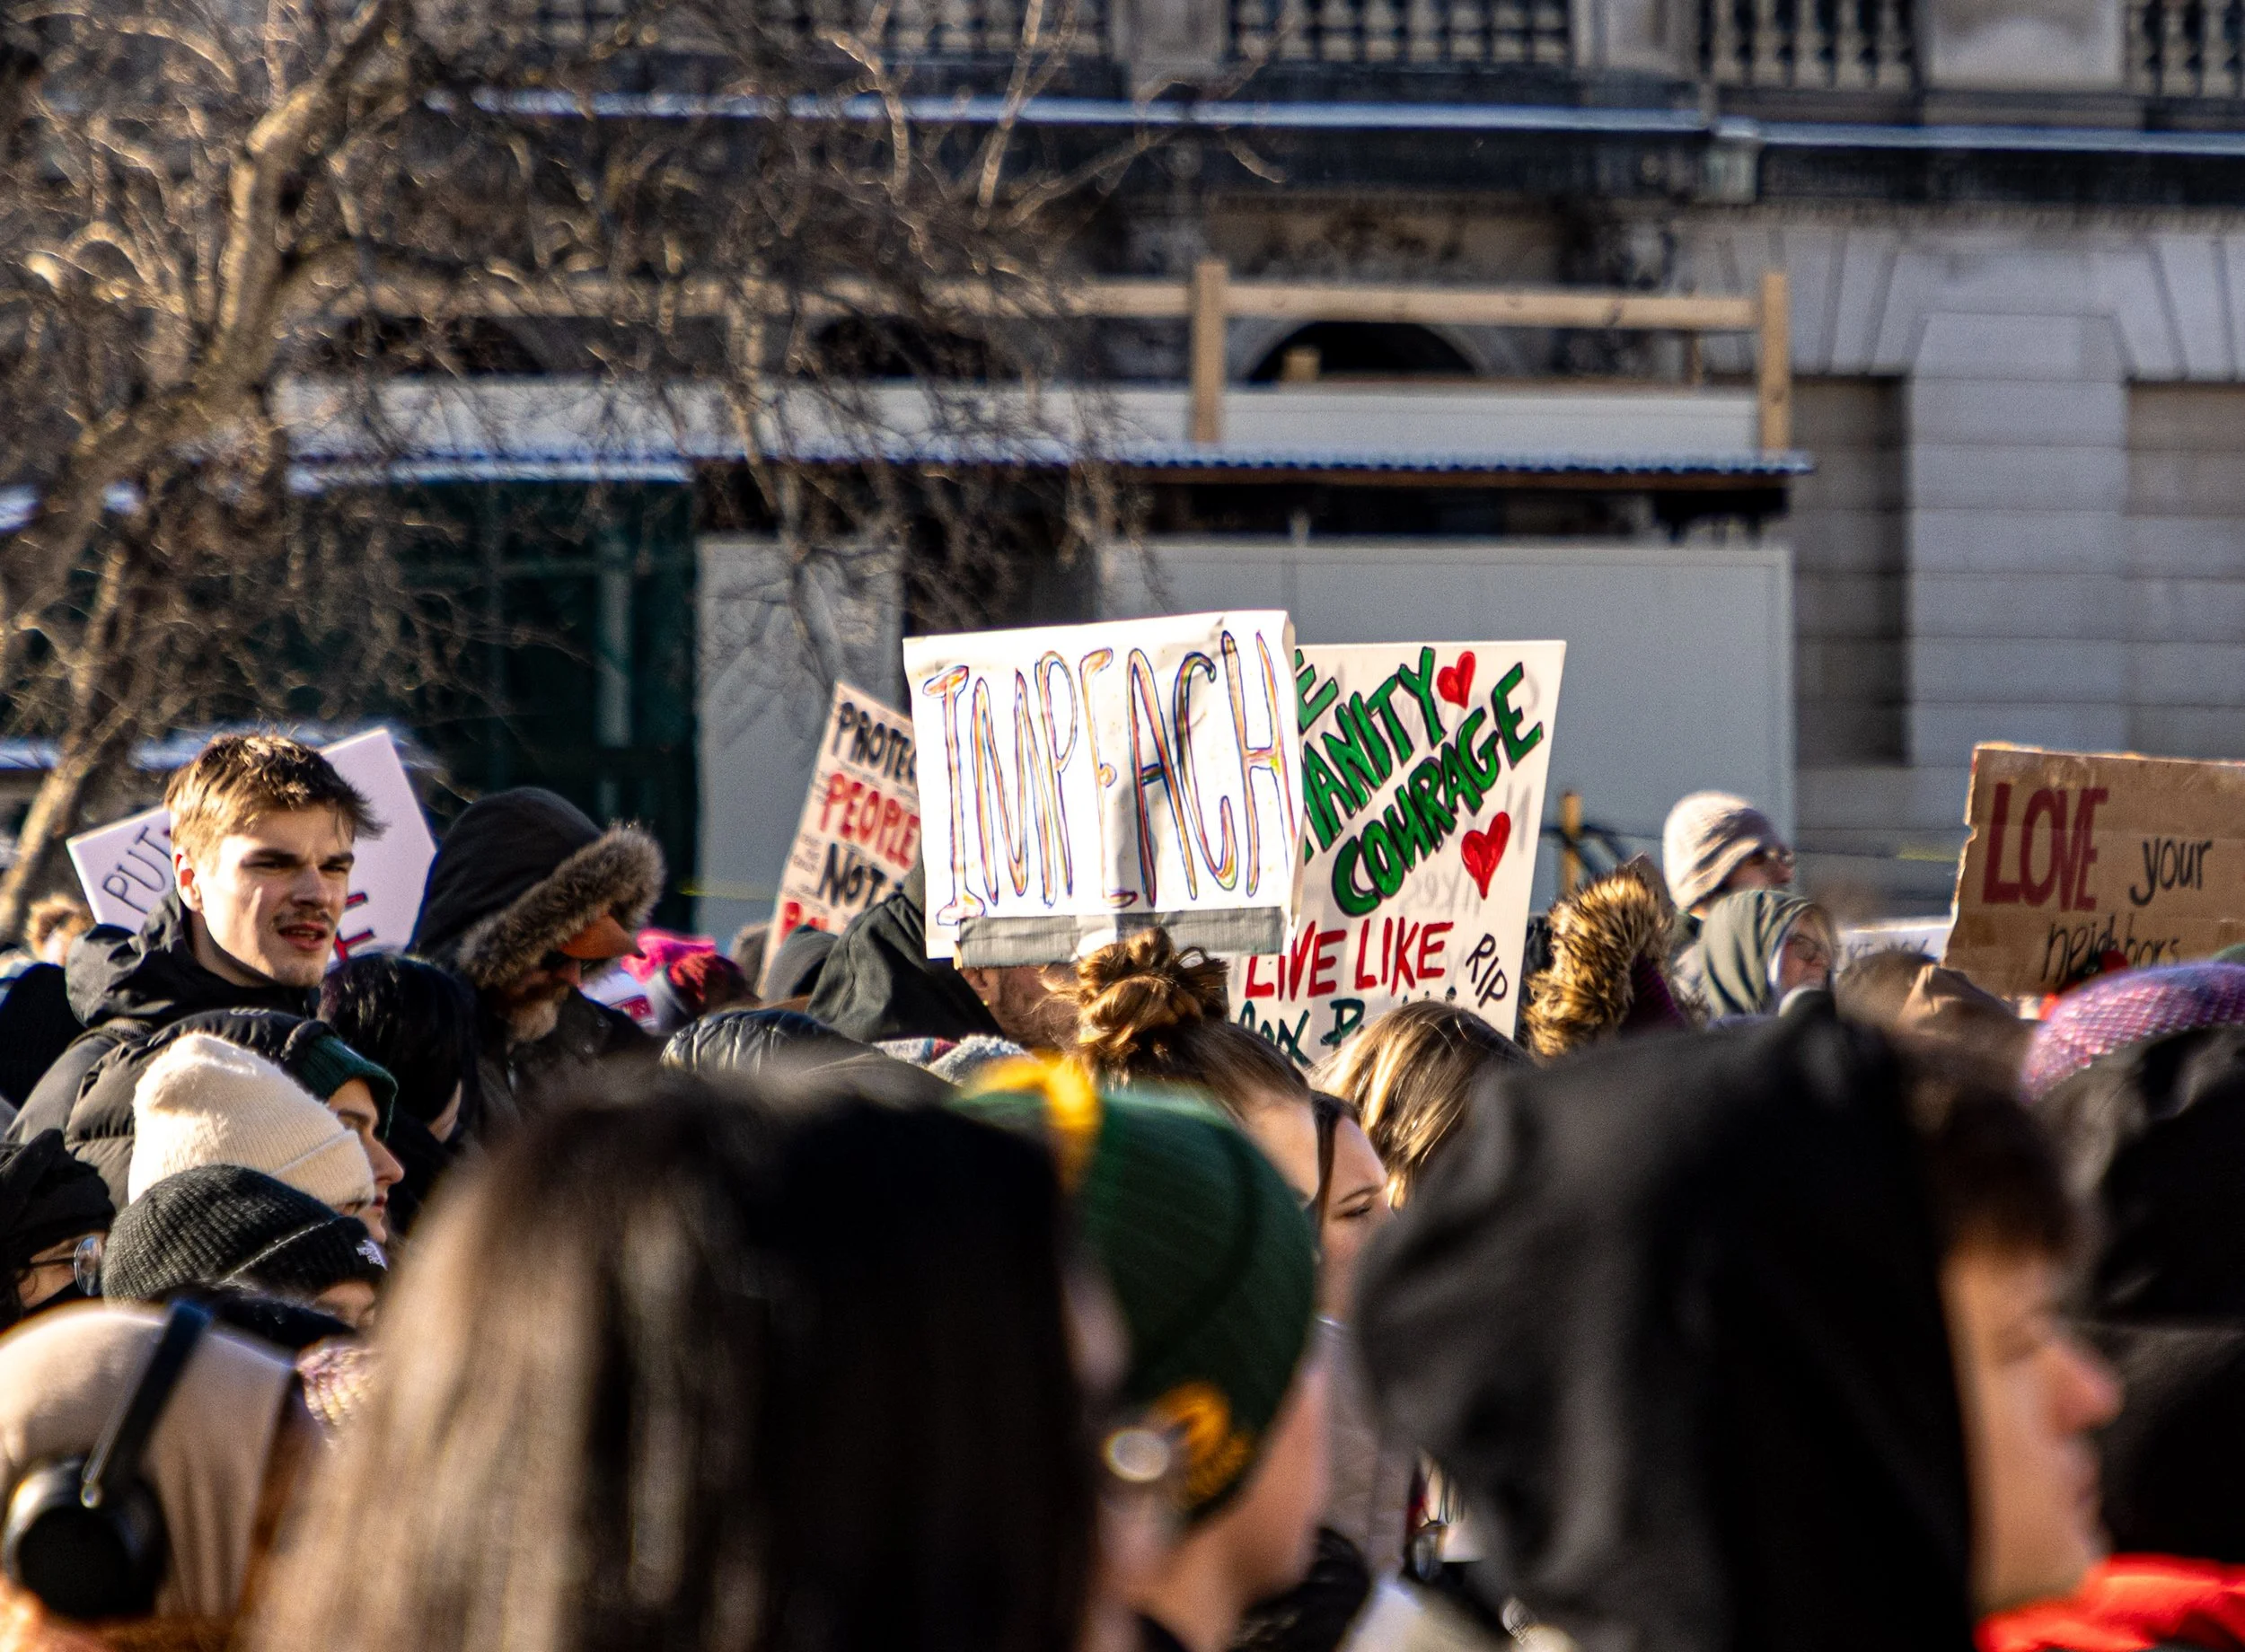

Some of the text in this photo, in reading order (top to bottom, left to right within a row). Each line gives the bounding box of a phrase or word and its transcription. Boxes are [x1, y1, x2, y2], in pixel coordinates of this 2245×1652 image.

[922, 630, 1299, 926] IMPEACH
[1301, 646, 1447, 866] ANITY
[1332, 662, 1543, 917] COURAGE
[819, 773, 920, 870] PEOPLE
[1982, 782, 2212, 912] LOVE your
[102, 826, 172, 914] PUT
[817, 842, 886, 908] NOT
[1245, 916, 1454, 1002] LIVE LIKE
[1466, 933, 1508, 1008] RIP
[1510, 1626, 1527, 1646] THE
